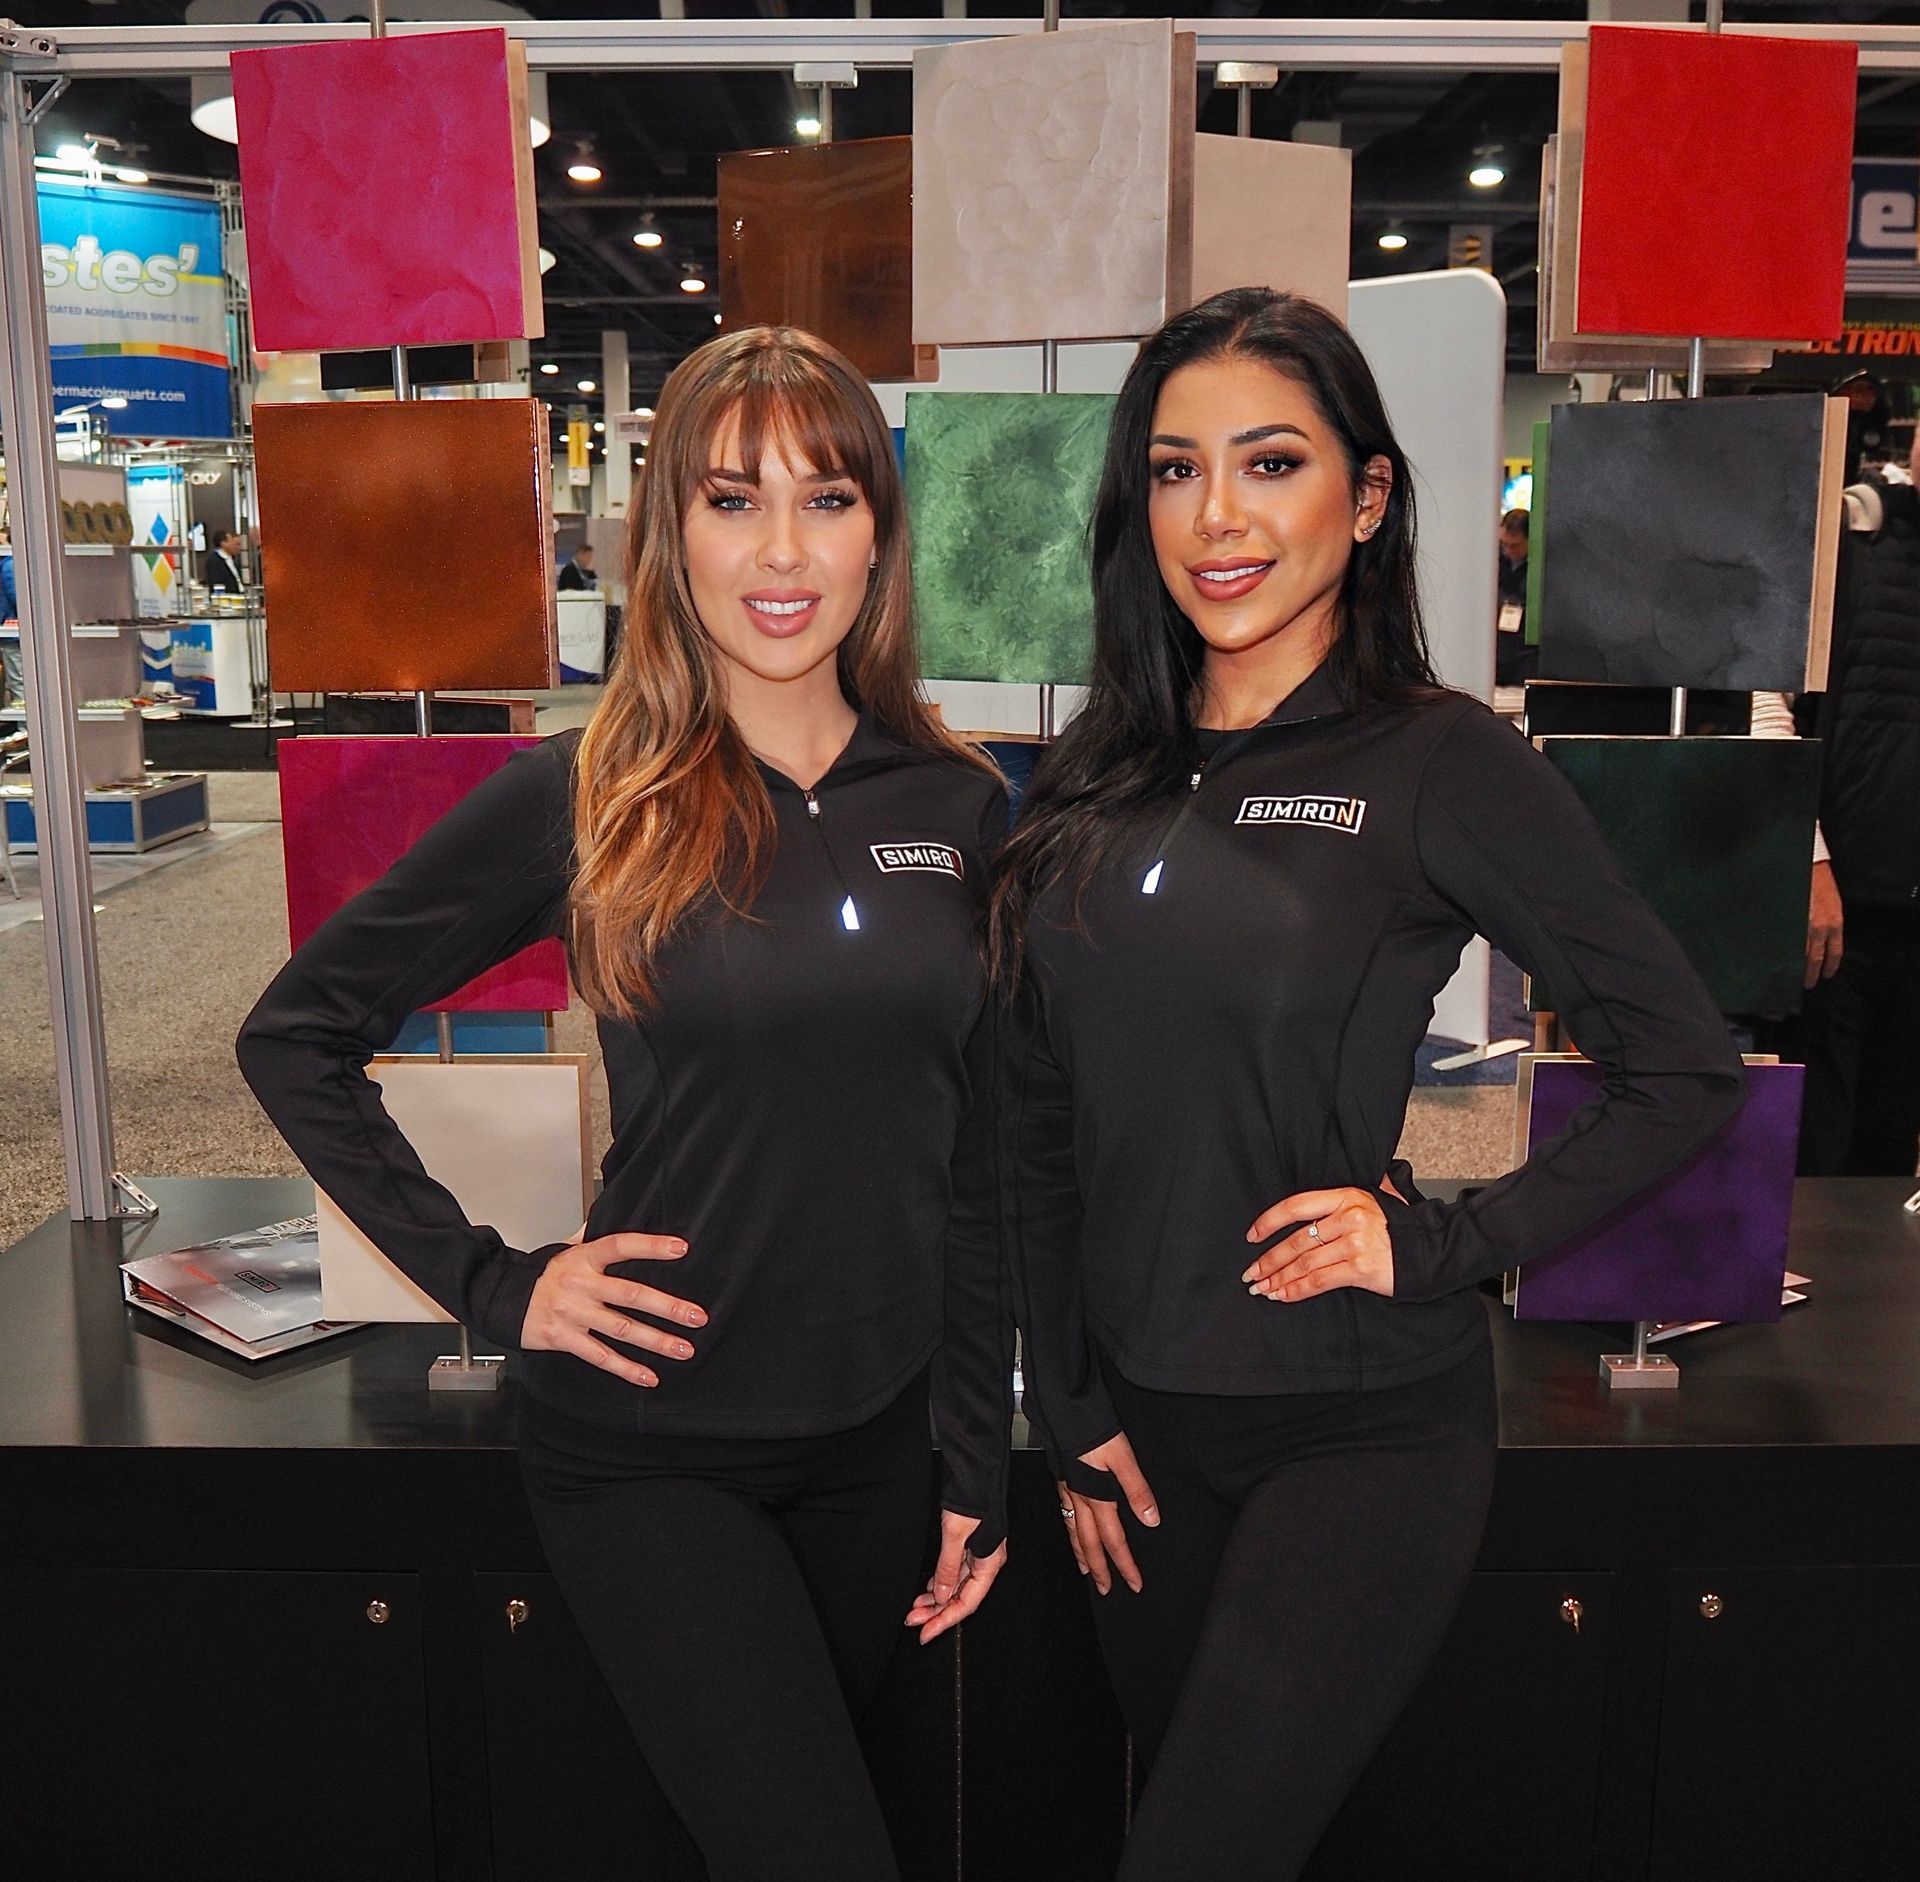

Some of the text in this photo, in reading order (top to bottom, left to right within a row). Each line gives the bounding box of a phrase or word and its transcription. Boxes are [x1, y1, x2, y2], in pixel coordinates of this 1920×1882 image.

[42, 235, 199, 297] stes'
[1246, 798, 1357, 826] SIMIRON
[882, 847, 957, 869] SIMIRO
